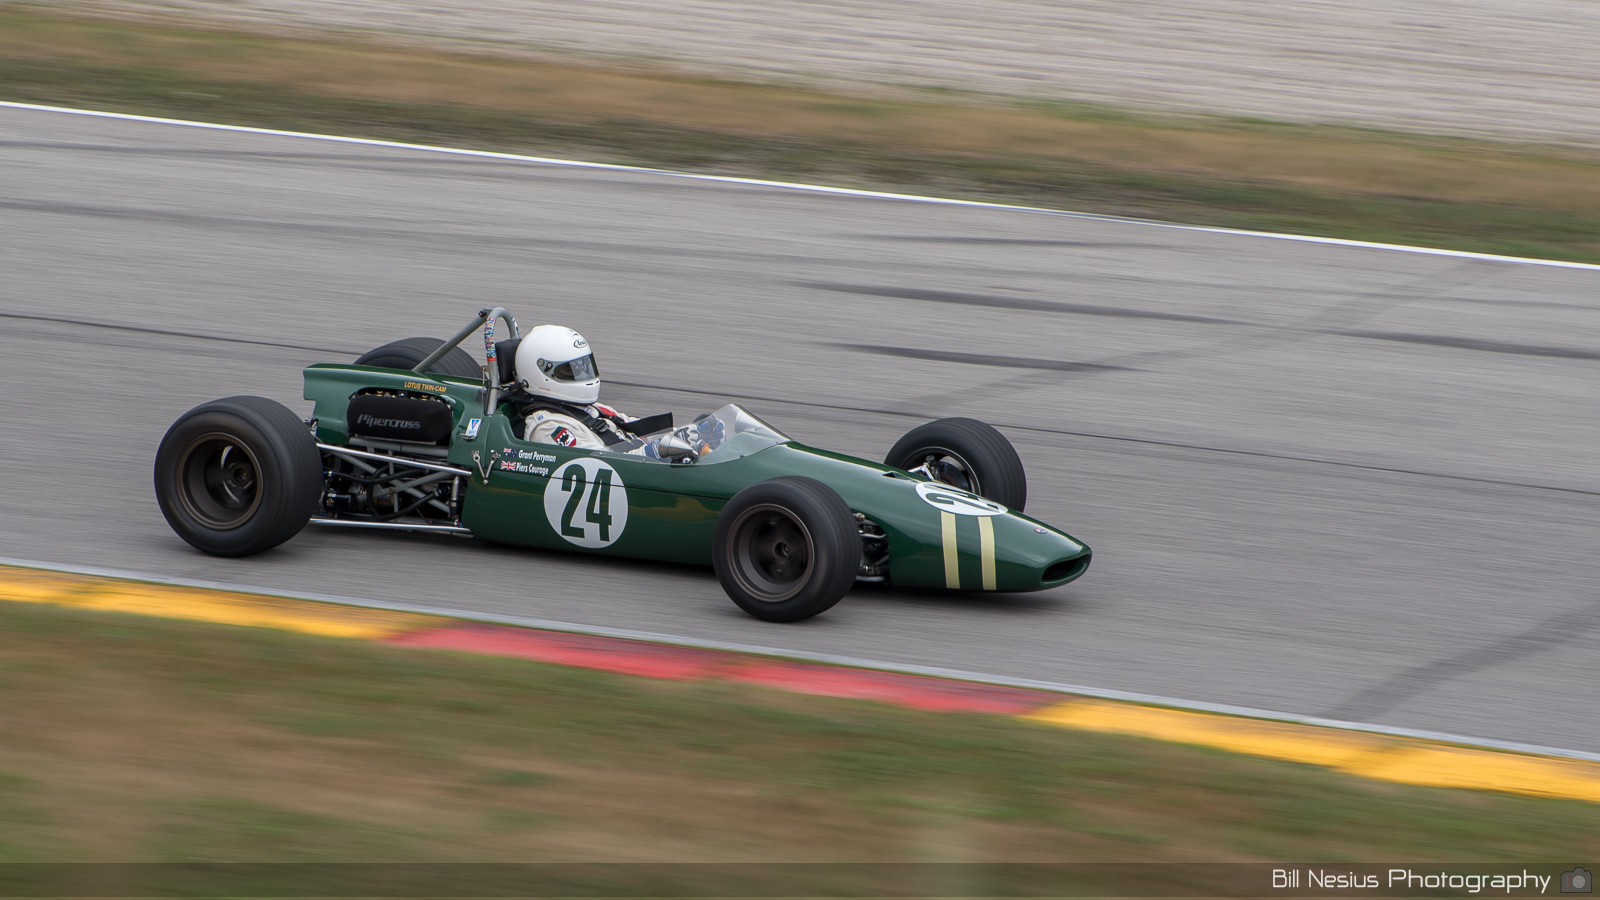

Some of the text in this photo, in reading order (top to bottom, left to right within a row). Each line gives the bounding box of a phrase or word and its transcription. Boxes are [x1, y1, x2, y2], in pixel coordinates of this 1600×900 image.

[404, 381, 447, 393] LOTUS TWIN-CAM
[357, 413, 421, 429] Pipercross
[518, 449, 557, 463] Grant Perryman
[516, 462, 549, 477] Piers Courage
[561, 463, 613, 542] 24
